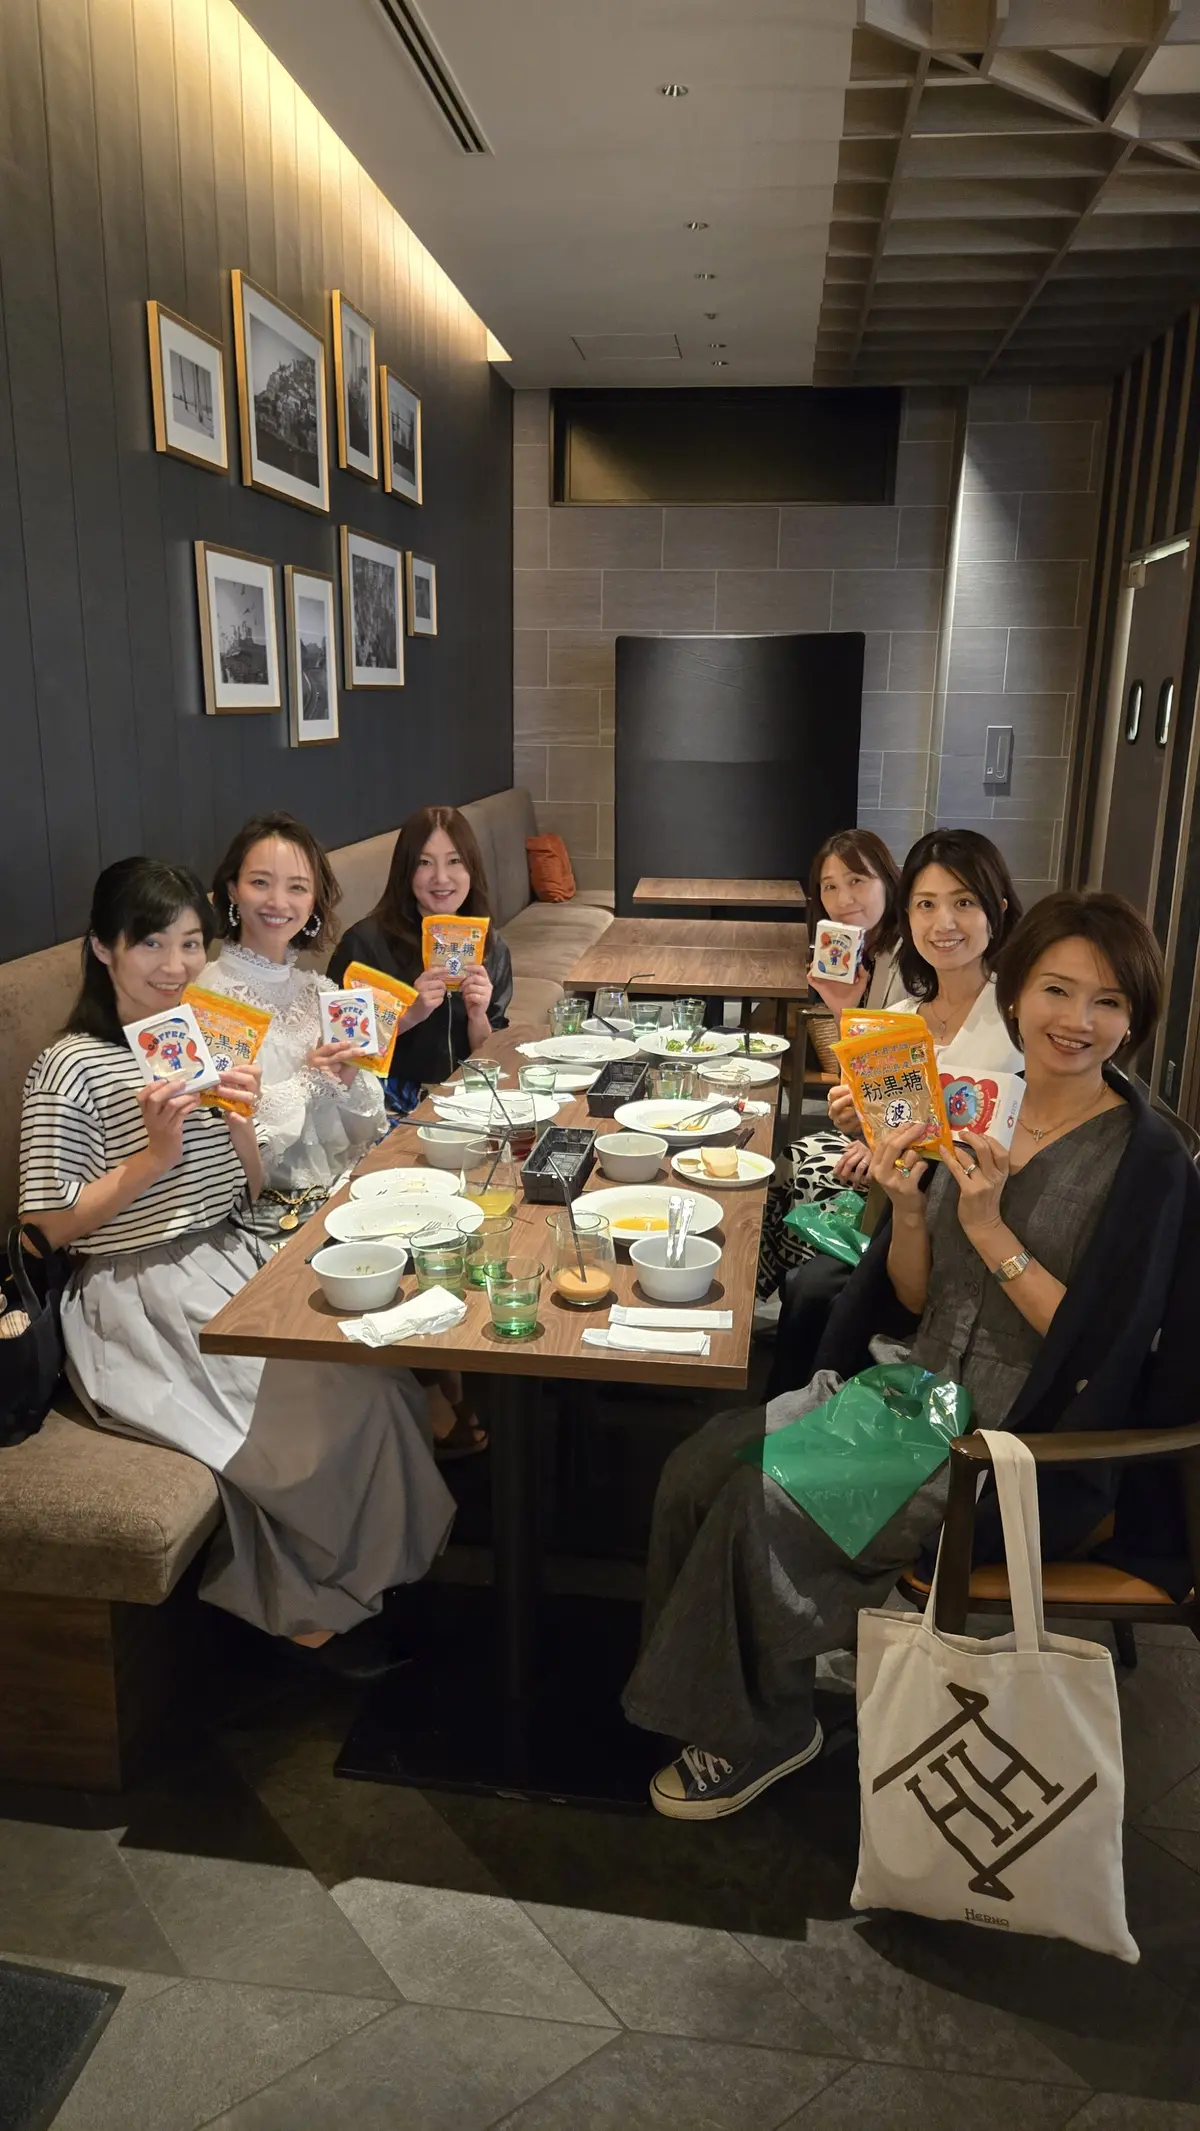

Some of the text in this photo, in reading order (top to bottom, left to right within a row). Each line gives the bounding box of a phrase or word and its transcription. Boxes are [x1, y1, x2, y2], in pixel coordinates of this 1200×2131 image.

[333, 1006, 364, 1019] COFFEE
[148, 1031, 186, 1050] COFFEE
[215, 1056, 229, 1072] 波
[861, 1070, 924, 1103] 粉黒糖
[892, 1103, 905, 1122] 波
